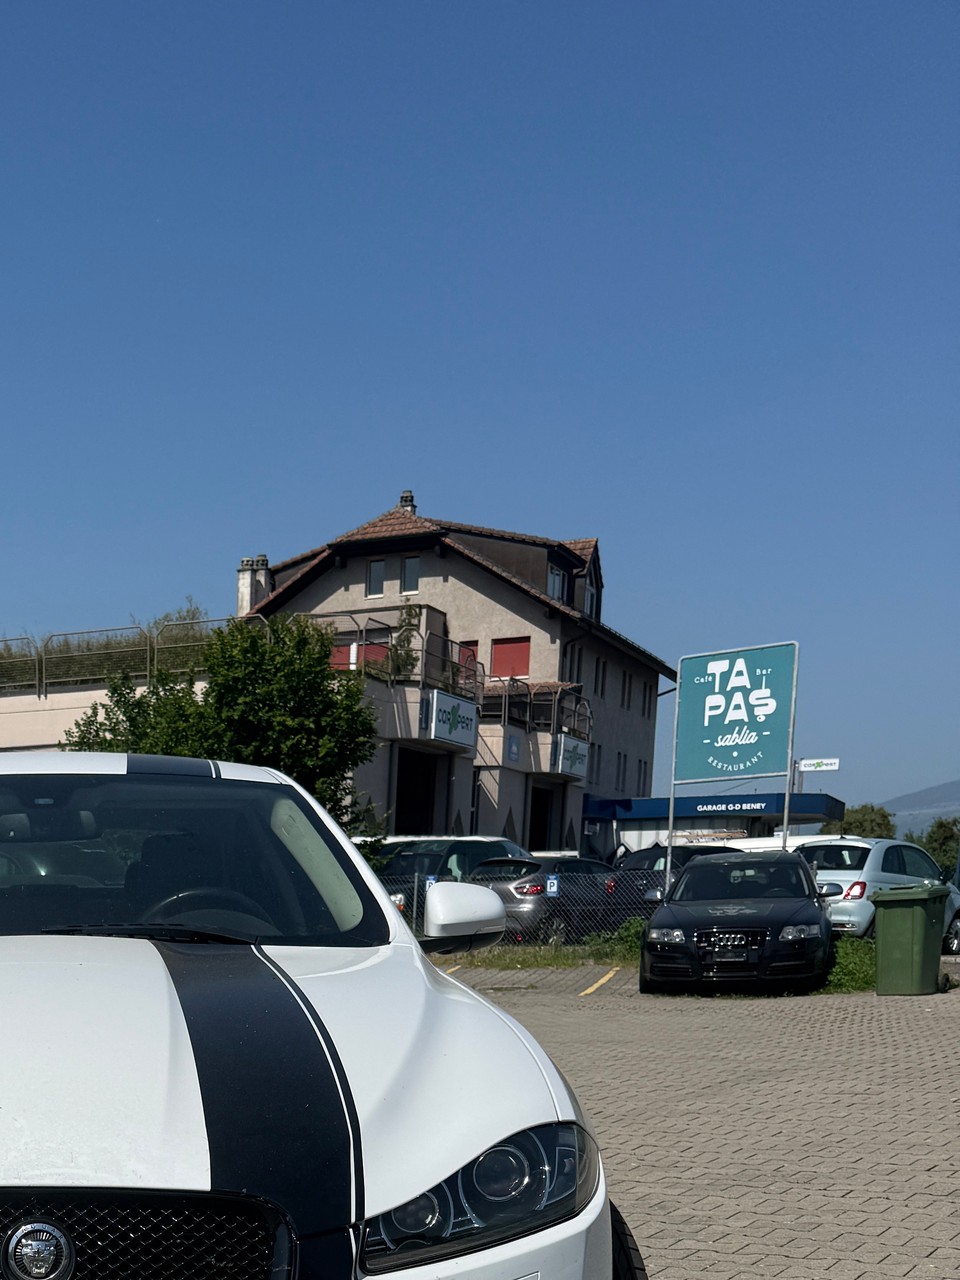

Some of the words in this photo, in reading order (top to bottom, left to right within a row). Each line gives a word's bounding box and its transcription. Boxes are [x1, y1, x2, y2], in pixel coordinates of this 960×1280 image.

[707, 658, 751, 692] TA
[714, 725, 758, 747] sablia
[707, 751, 763, 771] RESTAURANT
[727, 803, 741, 811] G-D
[15, 1223, 64, 1239] JAGUAR
